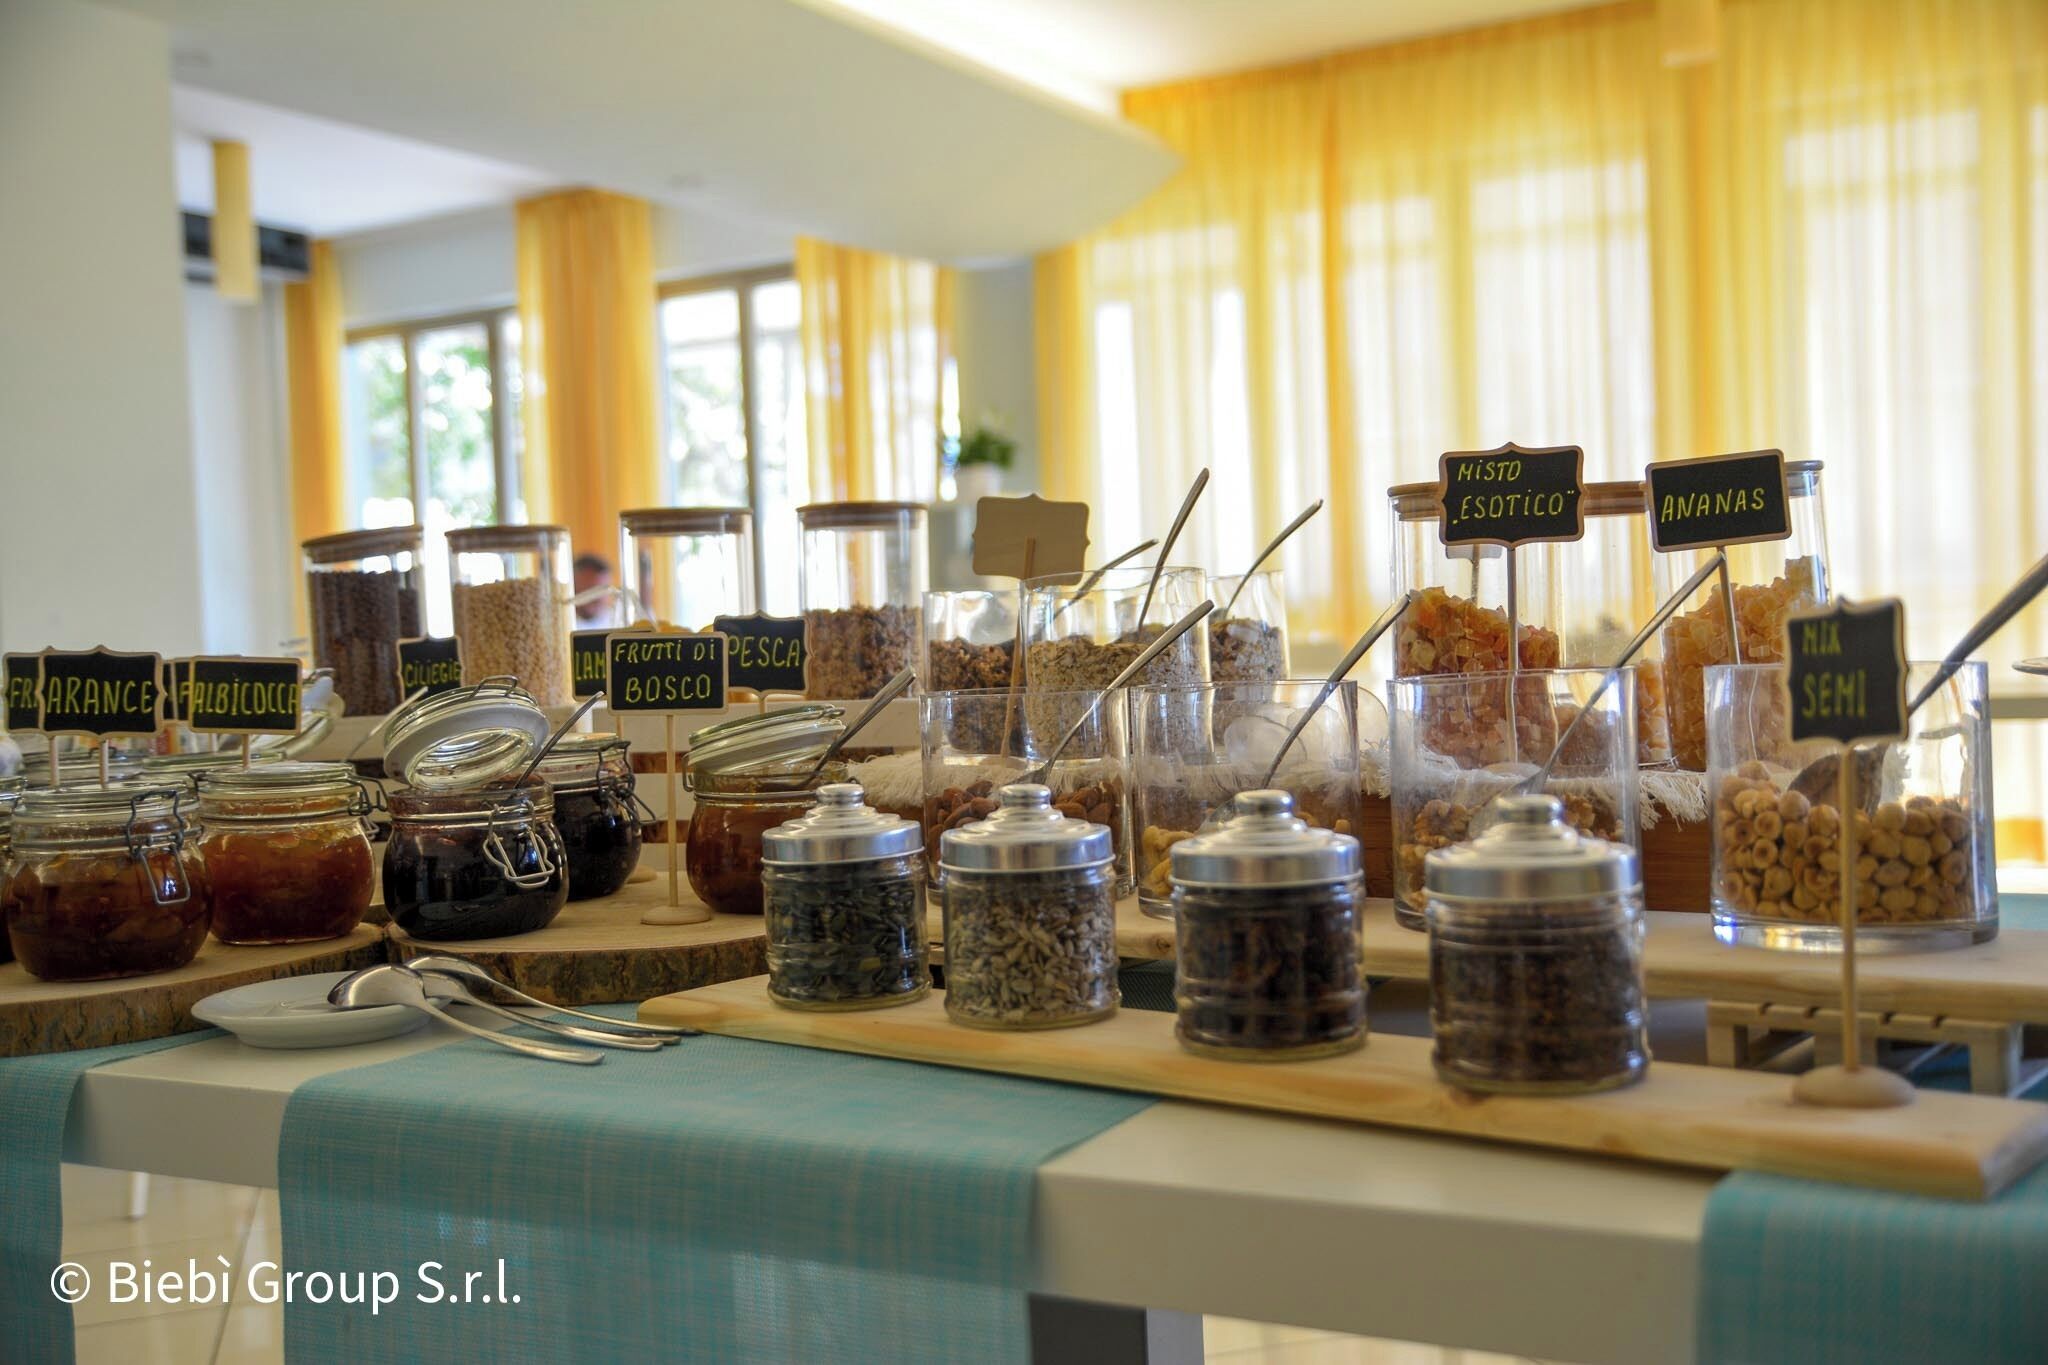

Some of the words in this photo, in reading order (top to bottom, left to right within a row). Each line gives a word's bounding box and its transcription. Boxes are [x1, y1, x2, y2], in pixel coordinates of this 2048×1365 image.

[1661, 488, 1765, 523] ANANAS
[728, 635, 800, 668] PESCA
[1801, 620, 1842, 655] MIX
[10, 677, 38, 708] FR
[46, 677, 153, 715] ARANCE
[625, 674, 711, 703] BOSCO
[1802, 669, 1867, 720] SEMI
